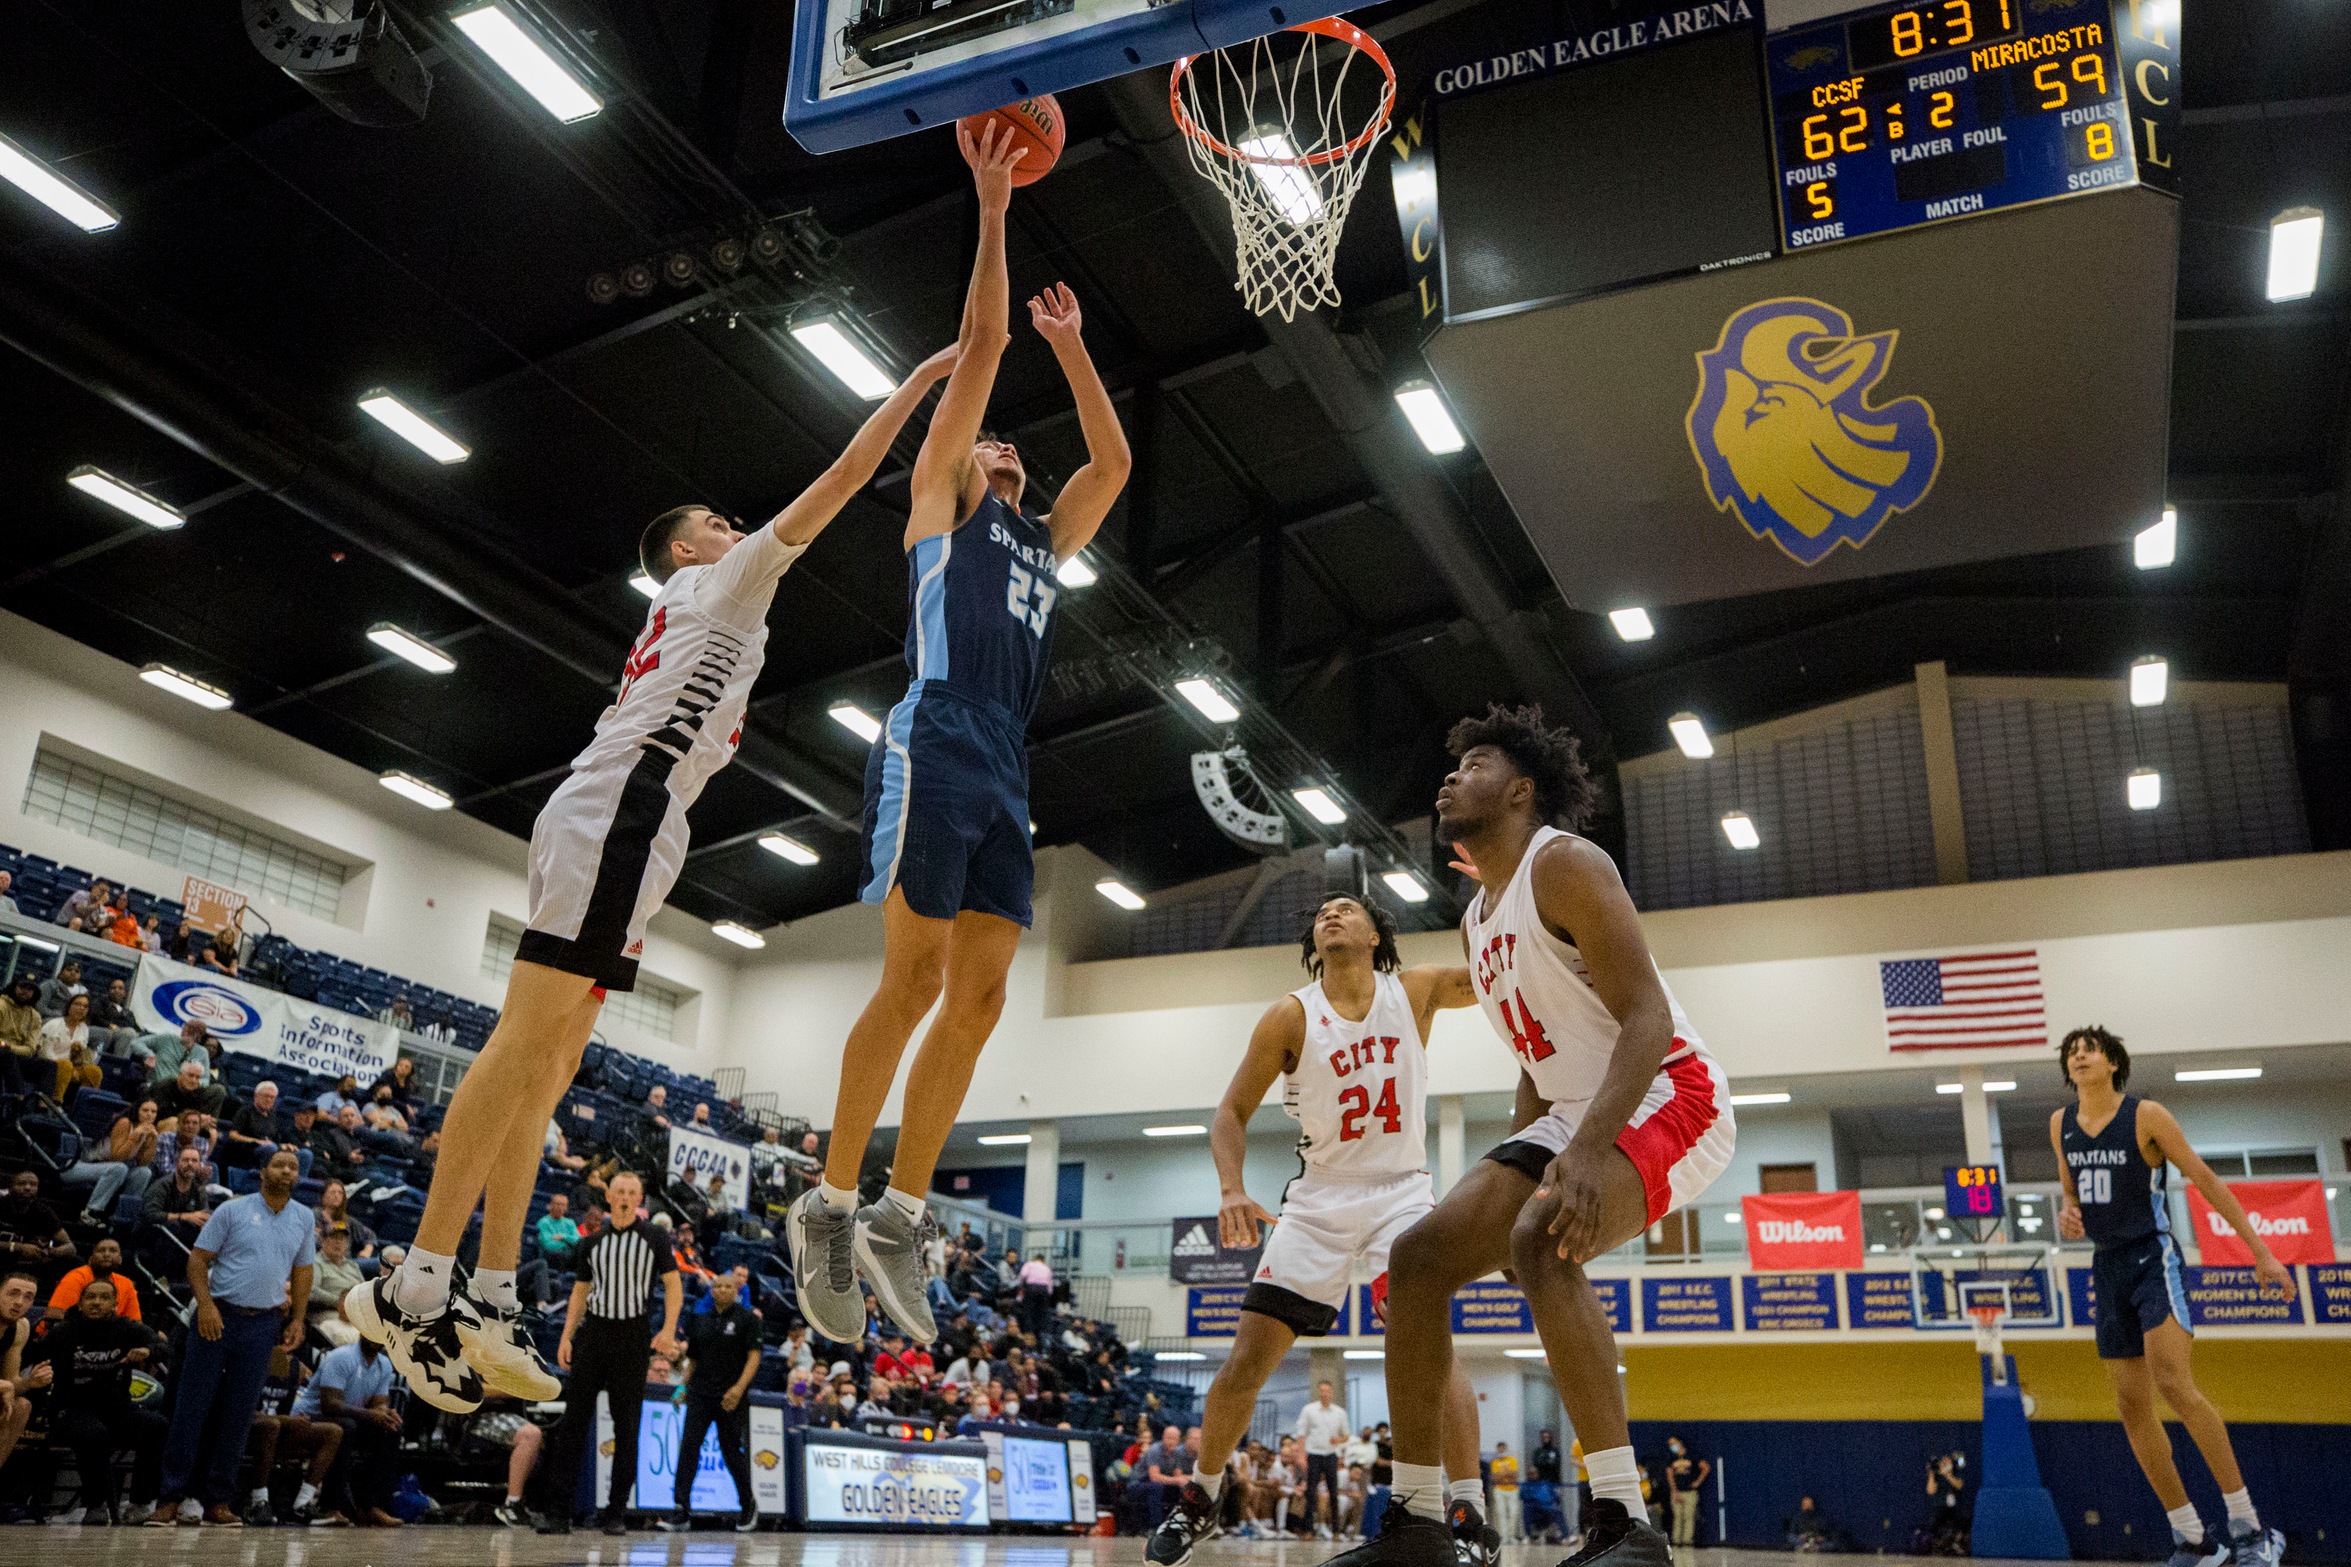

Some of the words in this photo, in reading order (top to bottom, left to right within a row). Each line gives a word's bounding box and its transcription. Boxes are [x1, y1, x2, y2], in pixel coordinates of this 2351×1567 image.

[1434, 46, 1546, 94] GOLDEN
[1552, 21, 1648, 66] EAGLE
[1653, 0, 1754, 42] ARENA
[1971, 23, 2103, 73] MIRACOSTA
[1812, 77, 1865, 108] CCSF
[1909, 66, 1968, 92] PERIOD
[2033, 53, 2107, 110] 59
[1930, 91, 1954, 128] 2
[2061, 102, 2118, 127] FOULS
[1802, 106, 1867, 161] 62
[1890, 138, 1953, 164] PLAYER
[1963, 126, 2007, 149] FOUL
[2085, 122, 2114, 161] 8
[1786, 162, 1837, 187] FOULS
[2067, 165, 2125, 190] SCORE
[1806, 182, 1833, 220] 5
[1926, 193, 1984, 220] MATCH
[1792, 222, 1845, 247] SCORE
[1700, 251, 1772, 272] DAKTRONICS
[1007, 559, 1057, 640] 23
[185, 896, 200, 914] 13
[187, 880, 244, 909] SECTION
[1478, 933, 1517, 995] CITY
[309, 1016, 367, 1046] Sports
[1499, 987, 1557, 1064] 44
[280, 1024, 384, 1067] Information
[1329, 1036, 1400, 1077] CITY
[1338, 1076, 1401, 1142] 24
[2067, 1150, 2127, 1167] SPARTANS
[2078, 1169, 2111, 1204] 20
[1757, 1220, 1845, 1243] Wilson
[2207, 1211, 2310, 1236] Wlson
[2202, 1271, 2235, 1285] 2017
[2203, 1304, 2291, 1319] CHAMPIONS
[813, 1450, 847, 1469] WEST
[851, 1453, 881, 1471] HILLS
[842, 1483, 904, 1514] GOLDEN
[909, 1487, 962, 1516] EAGLES
